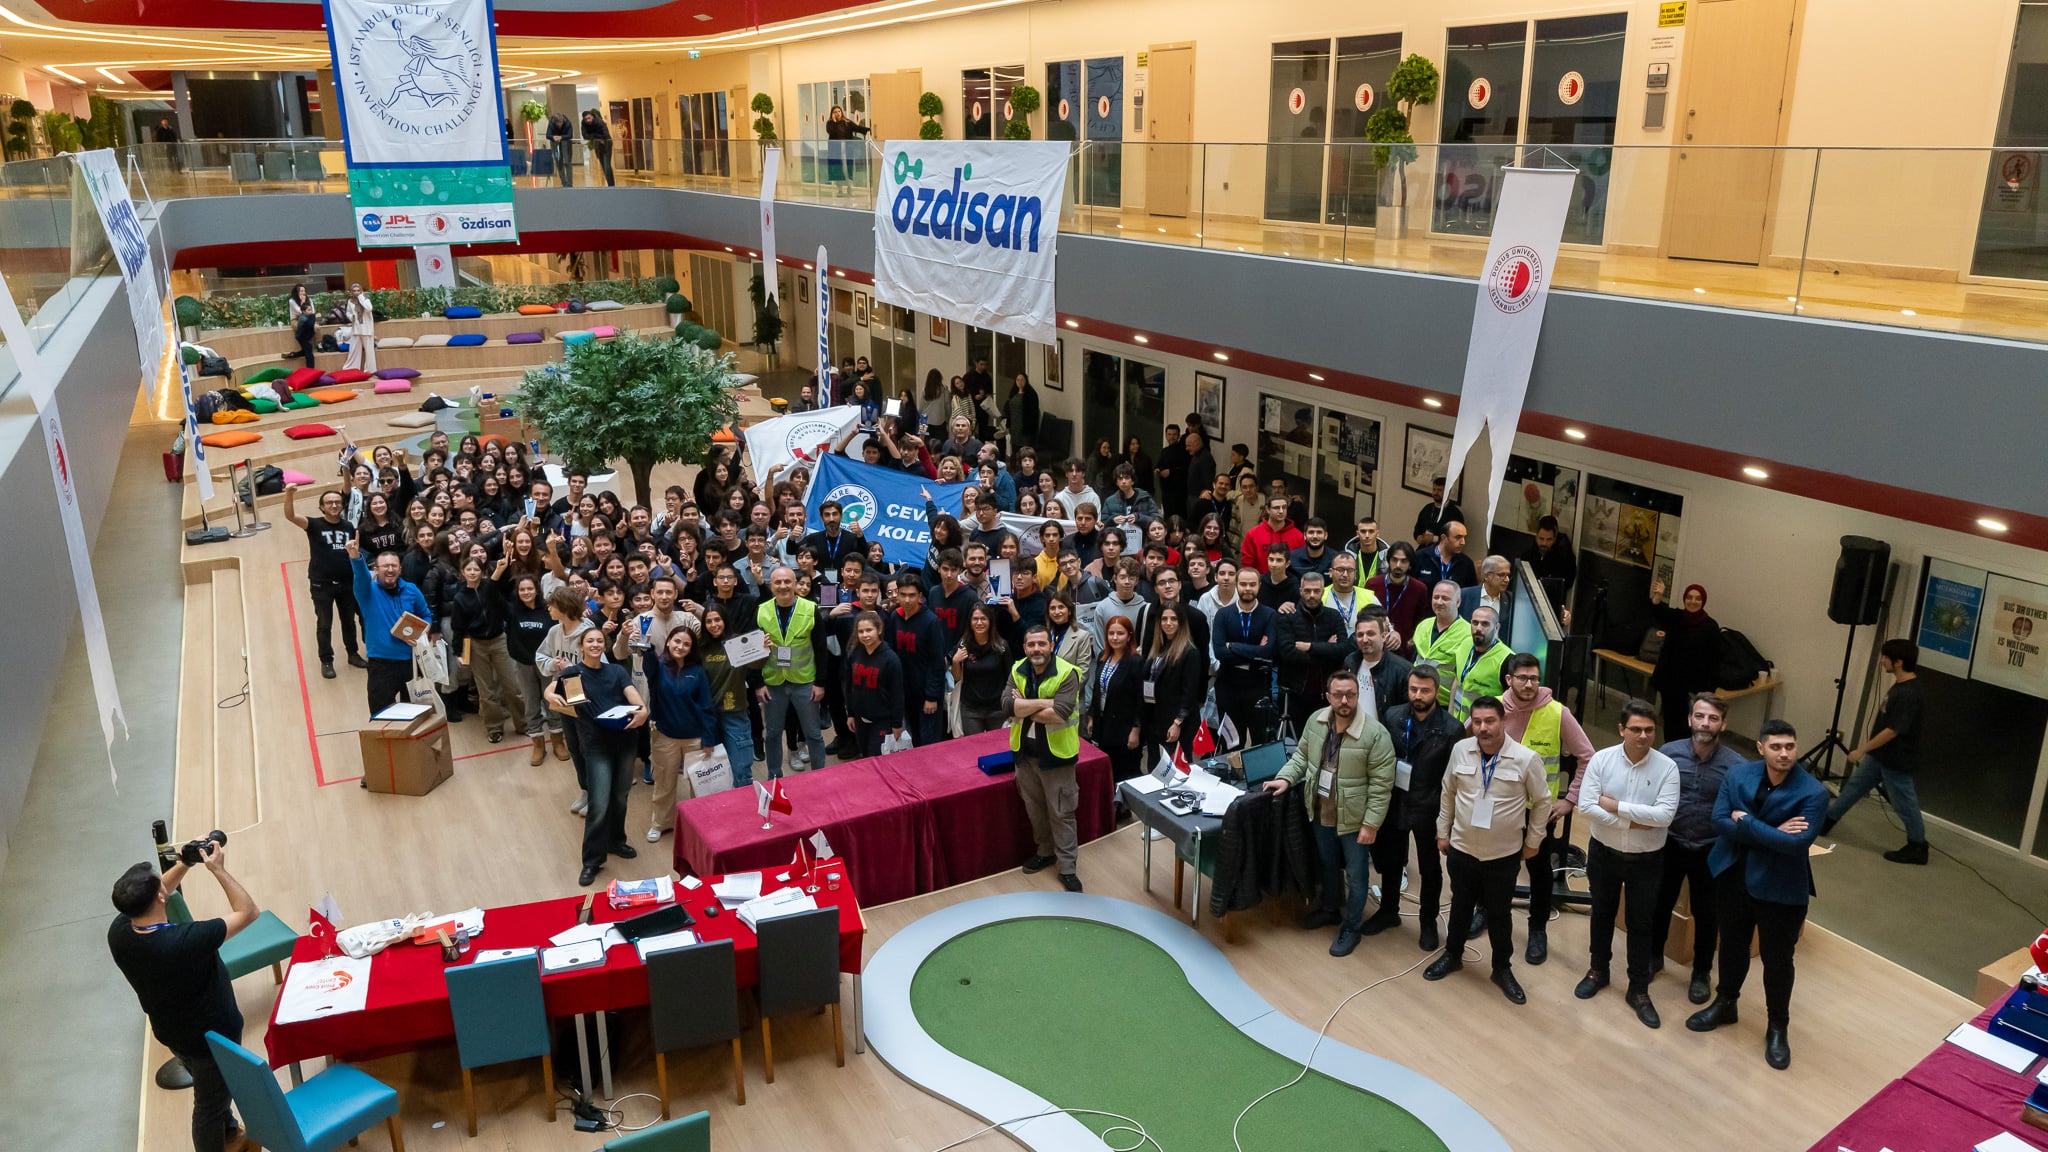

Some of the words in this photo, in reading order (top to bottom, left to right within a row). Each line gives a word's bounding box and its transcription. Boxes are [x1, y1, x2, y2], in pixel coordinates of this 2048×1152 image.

[347, 9, 391, 66] İSTANBUL
[394, 5, 443, 23] BULUŞ
[354, 80, 420, 135] INVENTION
[424, 80, 483, 136] CHALLENGE
[385, 215, 415, 225] JPL
[2003, 602, 2015, 612] BIG
[2016, 604, 2048, 620] BROTHER
[1997, 636, 2005, 646] IS
[2006, 638, 2040, 655] WATCHING
[2007, 649, 2026, 668] YOU
